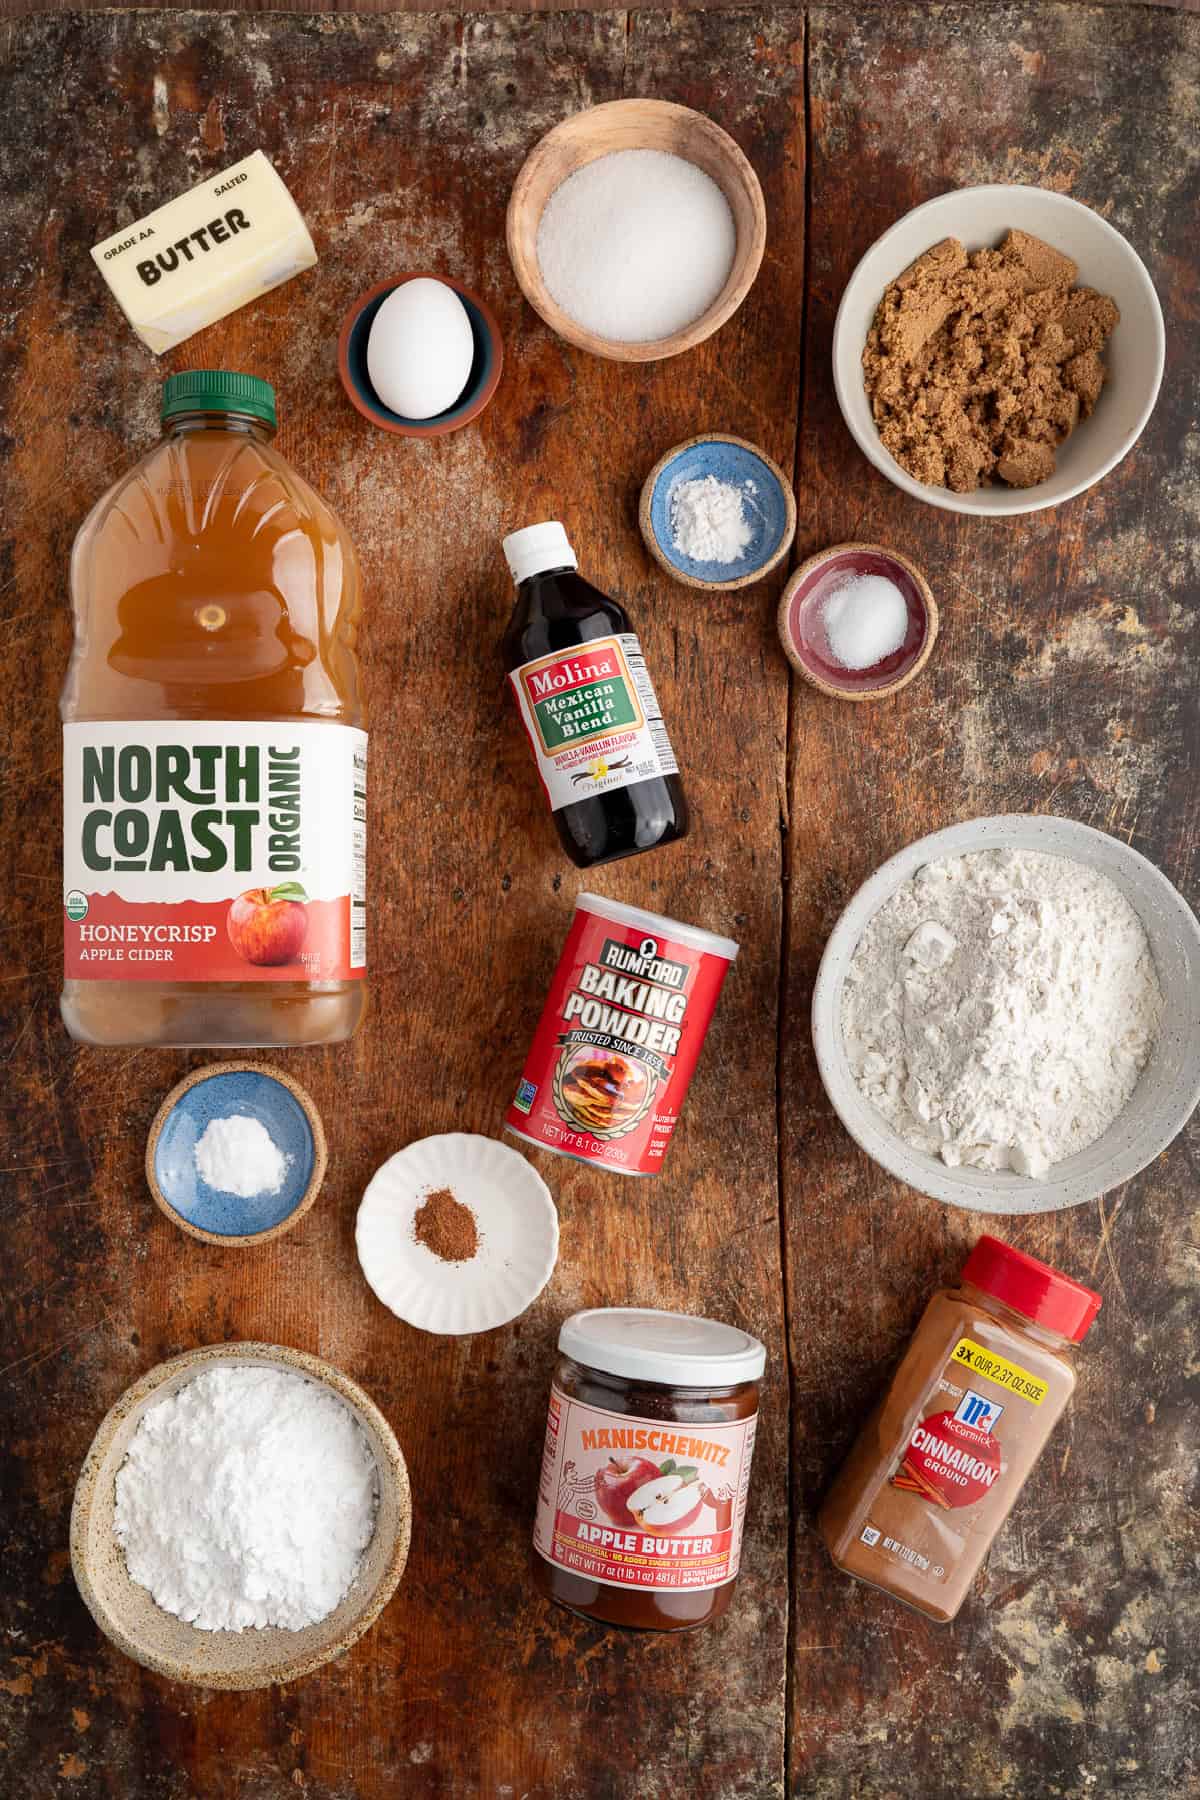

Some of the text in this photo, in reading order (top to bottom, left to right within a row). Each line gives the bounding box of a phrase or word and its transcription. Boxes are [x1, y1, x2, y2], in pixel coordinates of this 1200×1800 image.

[214, 173, 248, 196] SALTED
[103, 228, 155, 260] GRADE AA
[136, 208, 251, 286] BUTTER
[530, 662, 613, 696] Molina
[544, 684, 614, 714] Mexican
[552, 698, 615, 725] Vanilla
[561, 712, 613, 737] Blend
[82, 745, 260, 805] NORTH
[268, 746, 301, 872] ORGANIC
[82, 809, 260, 872] COAST
[80, 926, 217, 942] HONEYCRISP
[80, 949, 174, 961] APPLE CIDER
[606, 944, 682, 986] RUMFORD
[579, 964, 687, 1024] BAKING
[563, 993, 682, 1055] POWDER
[571, 1032, 611, 1046] TRUSTED
[611, 1039, 641, 1057] SINCE
[543, 1124, 559, 1138] NET
[560, 1132, 576, 1144] WT
[576, 1137, 589, 1149] 8.1
[591, 1143, 604, 1153] OZ
[956, 1346, 1044, 1400] 3X OUR 2.37 OZ SIZE
[581, 1429, 731, 1467] MANISCHEWITZ
[942, 1416, 992, 1448] McCormick
[911, 1428, 999, 1486] CINNAMON
[924, 1458, 968, 1486] GROUND
[577, 1523, 636, 1551] APPLE
[641, 1537, 713, 1555] BUTTER
[569, 1552, 583, 1565] NET
[584, 1559, 596, 1571] WT
[597, 1563, 606, 1573] 17
[626, 1567, 635, 1578] lb
